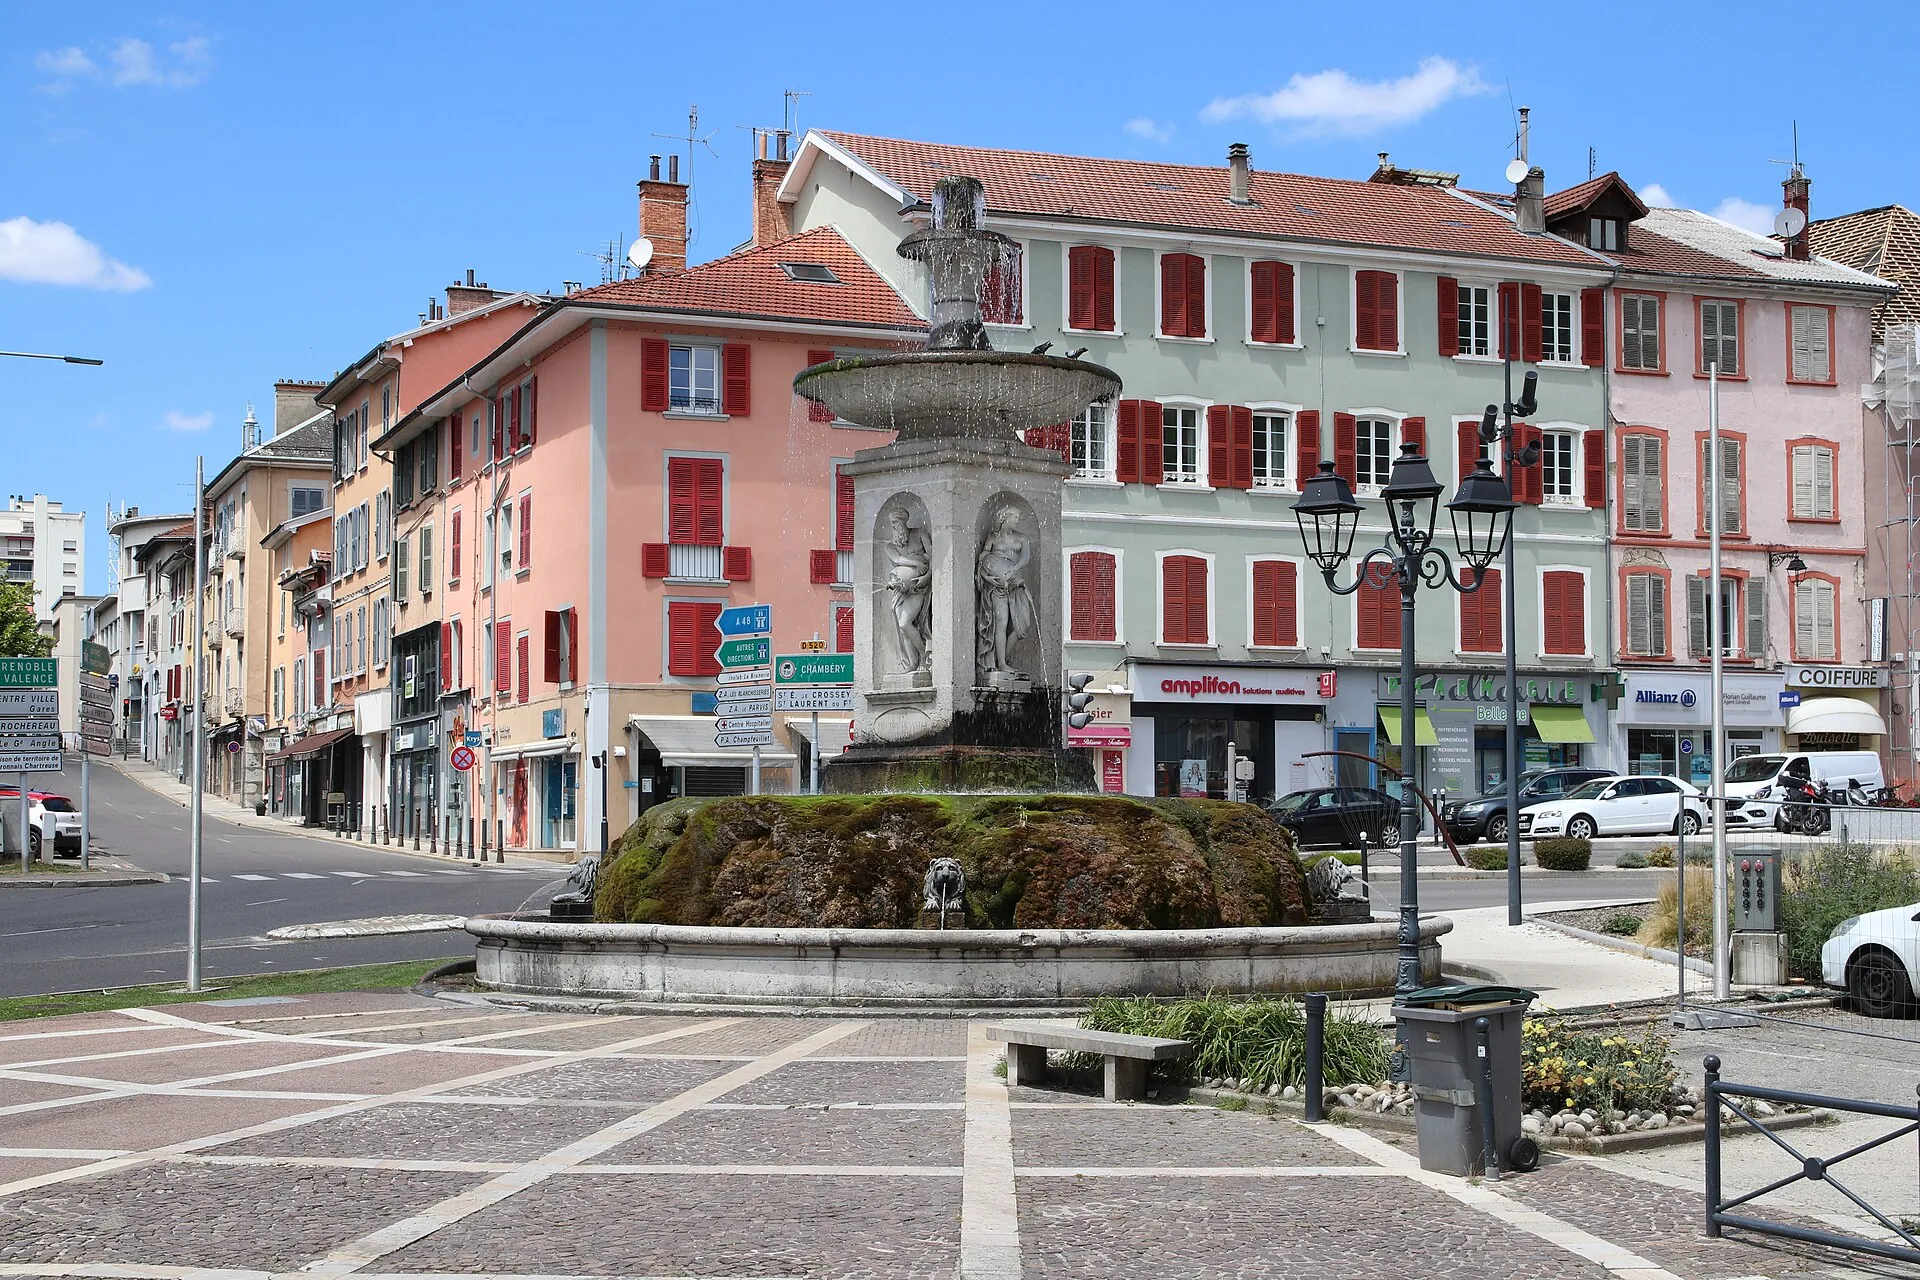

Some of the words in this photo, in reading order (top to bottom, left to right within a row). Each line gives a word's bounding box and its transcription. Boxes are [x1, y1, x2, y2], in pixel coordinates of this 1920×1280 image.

[735, 617, 741, 626] A
[741, 616, 751, 626] 48
[736, 643, 755, 651] AUTRES
[801, 642, 807, 650] D
[809, 641, 825, 650] 520
[727, 653, 755, 663] DIRECTIONS
[801, 662, 846, 674] CHAMBÉRY
[4, 674, 54, 683] VALENCE
[1798, 669, 1878, 686] COIFFURE
[1161, 675, 1241, 698] amplifon
[1242, 687, 1272, 695] Solutions
[1275, 687, 1306, 696] auditives
[31, 695, 55, 703] VILLE
[812, 691, 851, 699] CROSSEY
[1635, 690, 1679, 704] Allianz
[1741, 693, 1767, 701] Guillaume
[29, 704, 56, 713] Gares
[749, 703, 769, 711] PARVIS
[790, 700, 829, 708] LAURENT
[1476, 705, 1528, 721] Belleue
[0, 722, 56, 730] ROCHEREAU
[728, 720, 744, 728] Centre
[30, 739, 56, 749] Angle
[466, 736, 480, 745] Krys
[22, 755, 50, 763] territoire
[51, 754, 59, 762] de
[24, 762, 59, 770] Chartreuse
